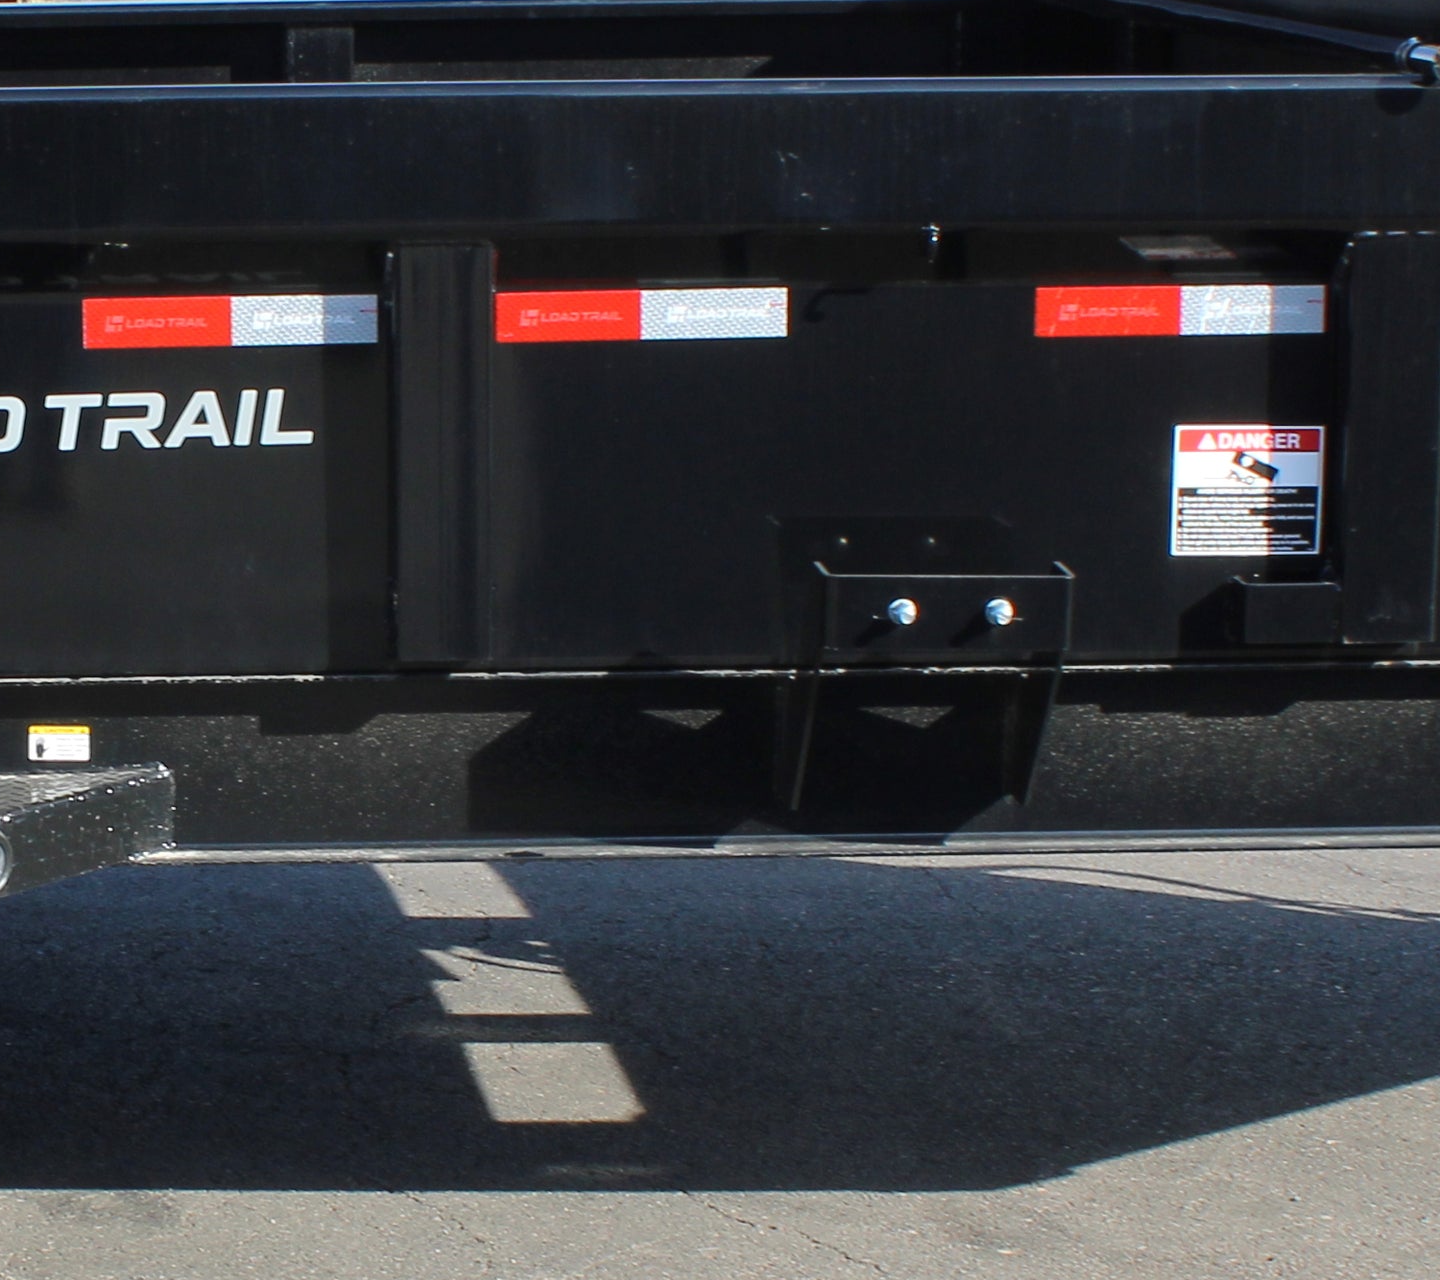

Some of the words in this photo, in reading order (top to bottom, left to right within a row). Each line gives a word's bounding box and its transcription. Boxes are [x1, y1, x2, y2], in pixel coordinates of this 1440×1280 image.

[125, 318, 165, 329] LOAD
[165, 317, 208, 328] TRAIL
[540, 311, 581, 322] LOAD
[580, 310, 623, 321] TRAIL
[43, 388, 314, 452] TRAIL
[1218, 433, 1301, 450] DANGER
